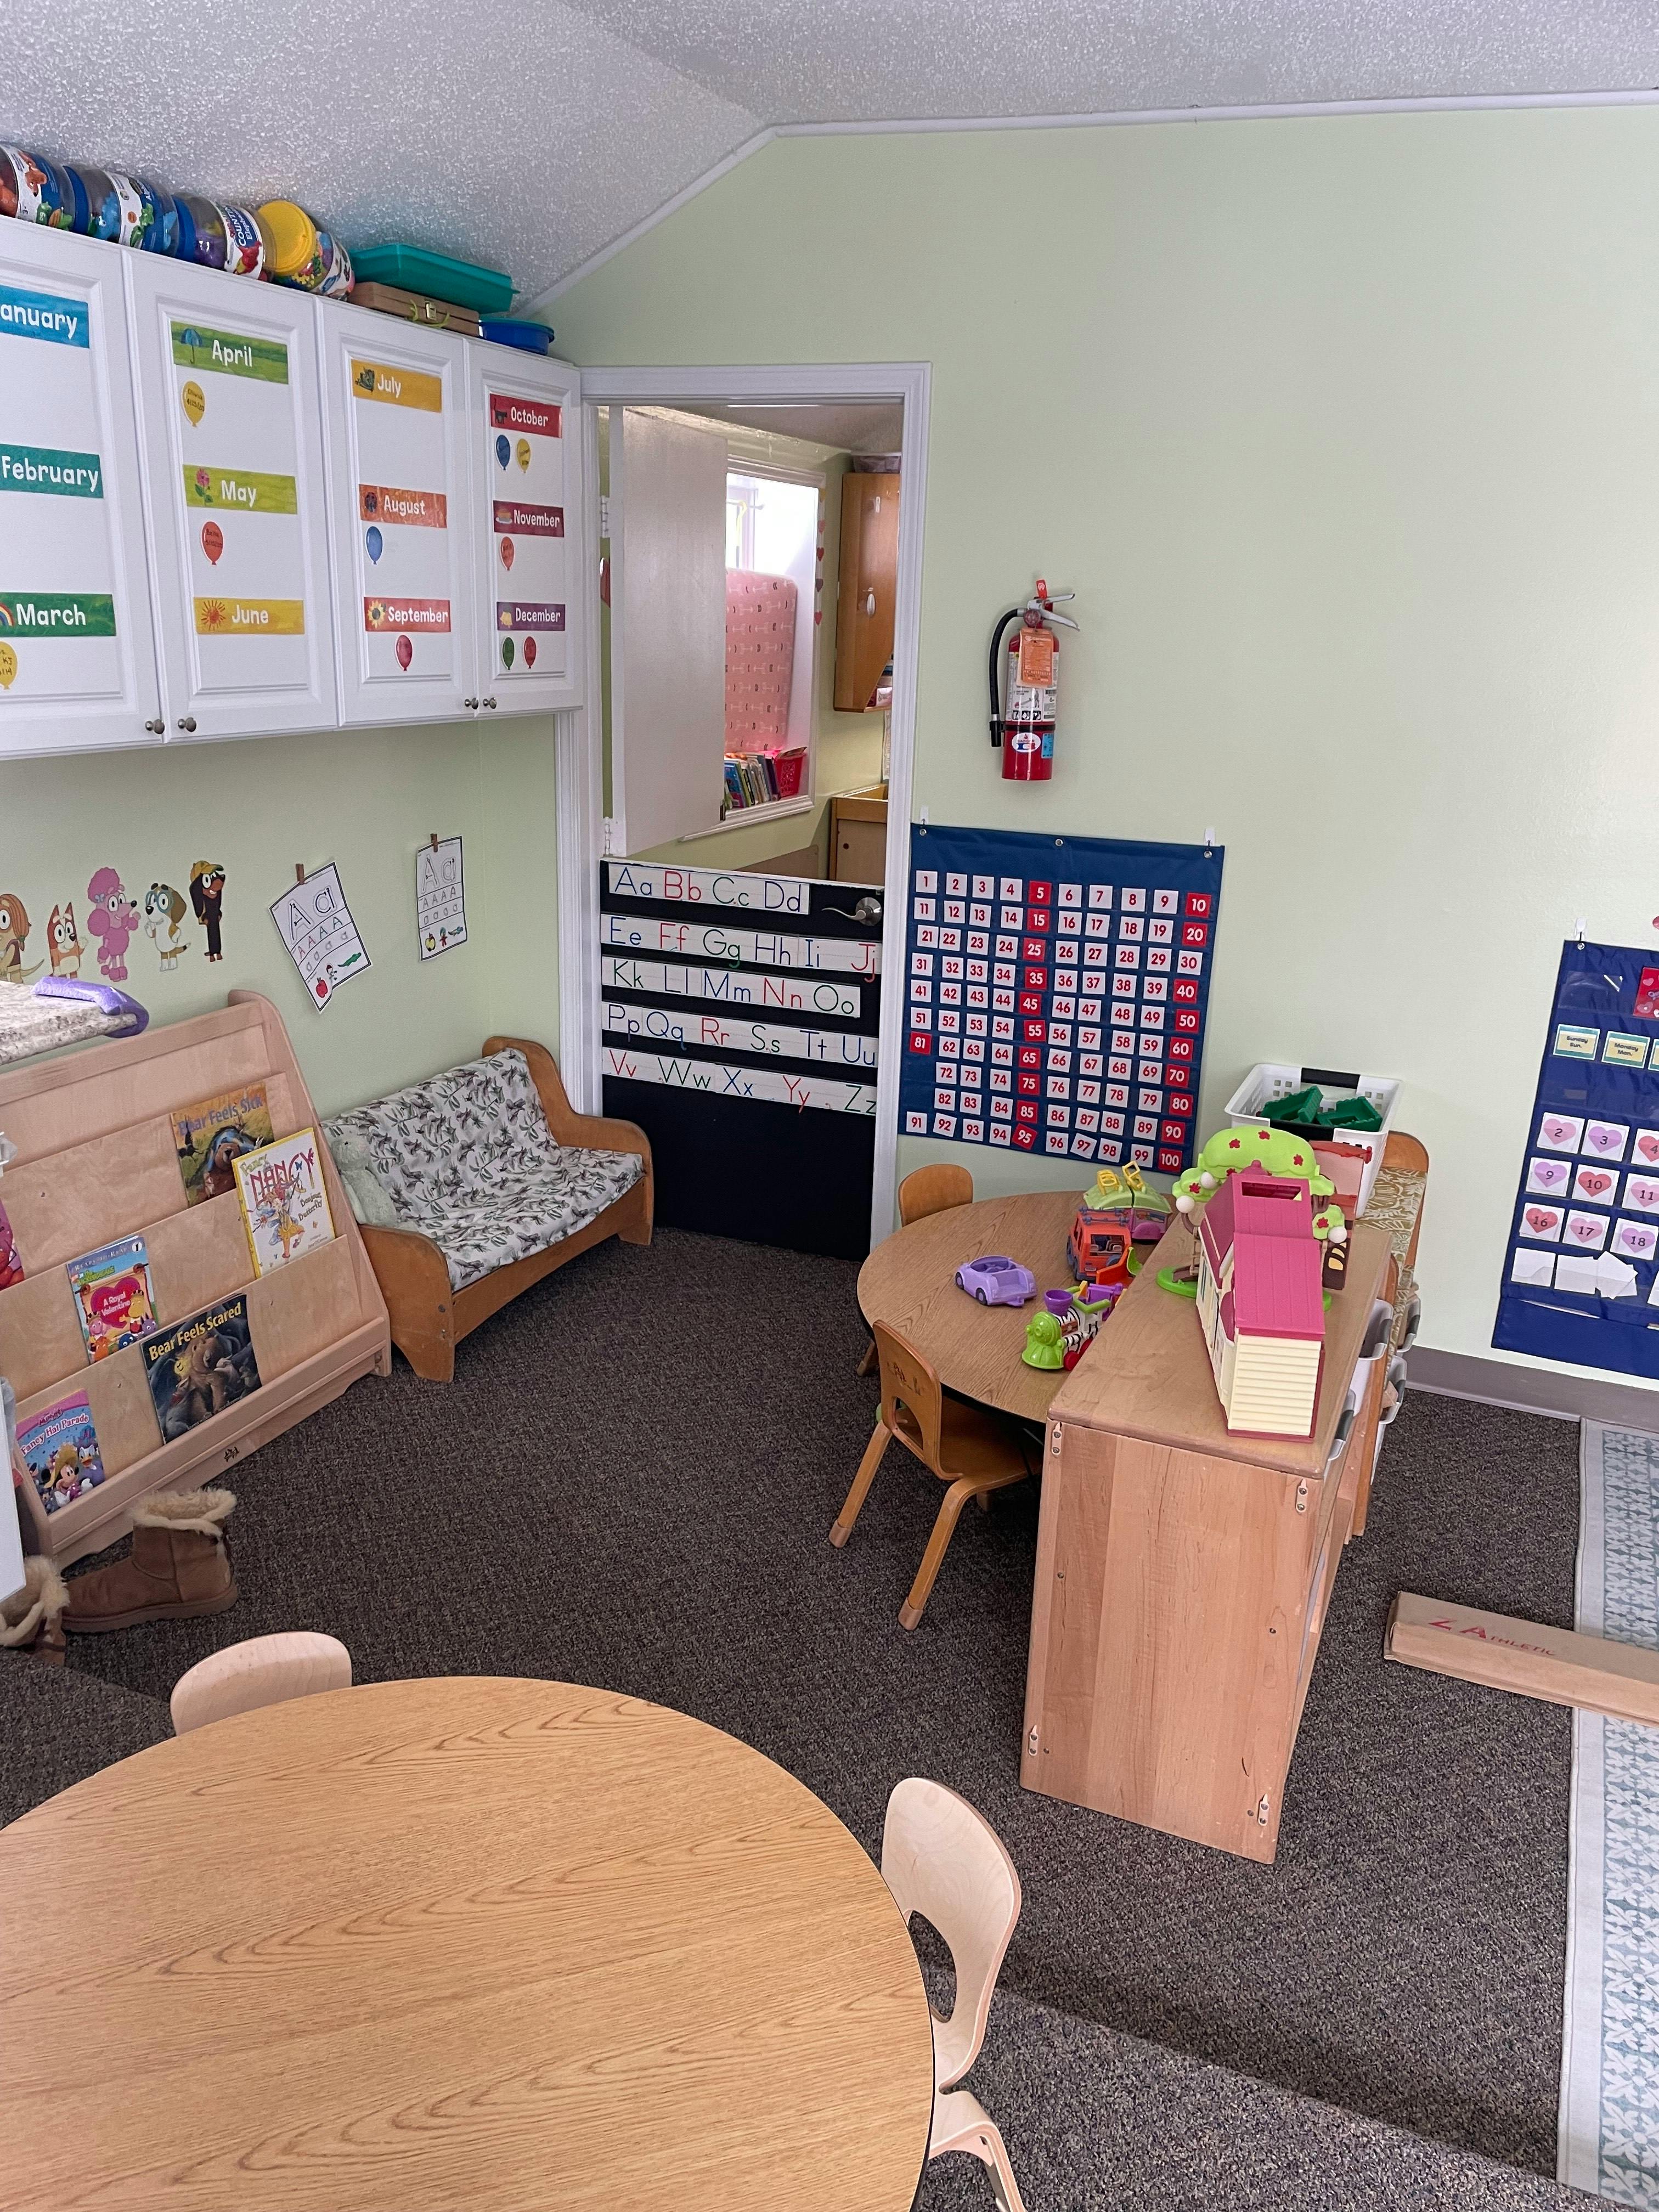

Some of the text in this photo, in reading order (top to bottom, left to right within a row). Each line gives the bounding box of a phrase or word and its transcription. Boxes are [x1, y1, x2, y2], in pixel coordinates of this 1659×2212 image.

[0, 303, 78, 339] anuary
[212, 339, 252, 367] April
[377, 374, 402, 398] July
[511, 406, 549, 427] October
[1, 455, 99, 492] February
[221, 480, 257, 507] May
[383, 495, 425, 518] August
[514, 509, 560, 528] November
[16, 603, 86, 626] March
[232, 604, 269, 624] June
[388, 606, 449, 625] September
[516, 607, 561, 623] December
[924, 876, 1206, 912] 1 2 3 4 5 6 7 8 9 10
[919, 902, 1204, 941] 11 12 13 14 15 16 17 18 19 20
[922, 930, 1198, 969] 21 22 23 24 25 26 27 28 29 30
[915, 985, 1195, 1028] 41 42 43 44 45 46 47 48 49 50
[915, 1012, 1189, 1056] 51 52 53 54 55 56 57 59 60
[1566, 1036, 1639, 1052] Sunday Monday
[915, 1036, 1185, 1082] 81 62 63 64 65 66 67 70
[208, 1104, 239, 1125] Feels
[240, 1096, 263, 1113] Sick
[938, 1093, 1181, 1138] 82 83 84 85 86 87 88 89 90
[911, 1116, 1180, 1167] 91 92 93 94 95 96 97 98 99 100
[1554, 1128, 1659, 1154] 2 3 4
[1545, 1170, 1654, 1200] 9 10 11
[1533, 1216, 1646, 1247] 16 17 18
[135, 1243, 139, 1251] 1
[103, 1291, 126, 1307] A Royal
[149, 1301, 242, 1361] Bear Feels Scared
[21, 1433, 44, 1455] Fancy
[45, 1424, 60, 1437] Hat
[61, 1414, 89, 1429] Parade
